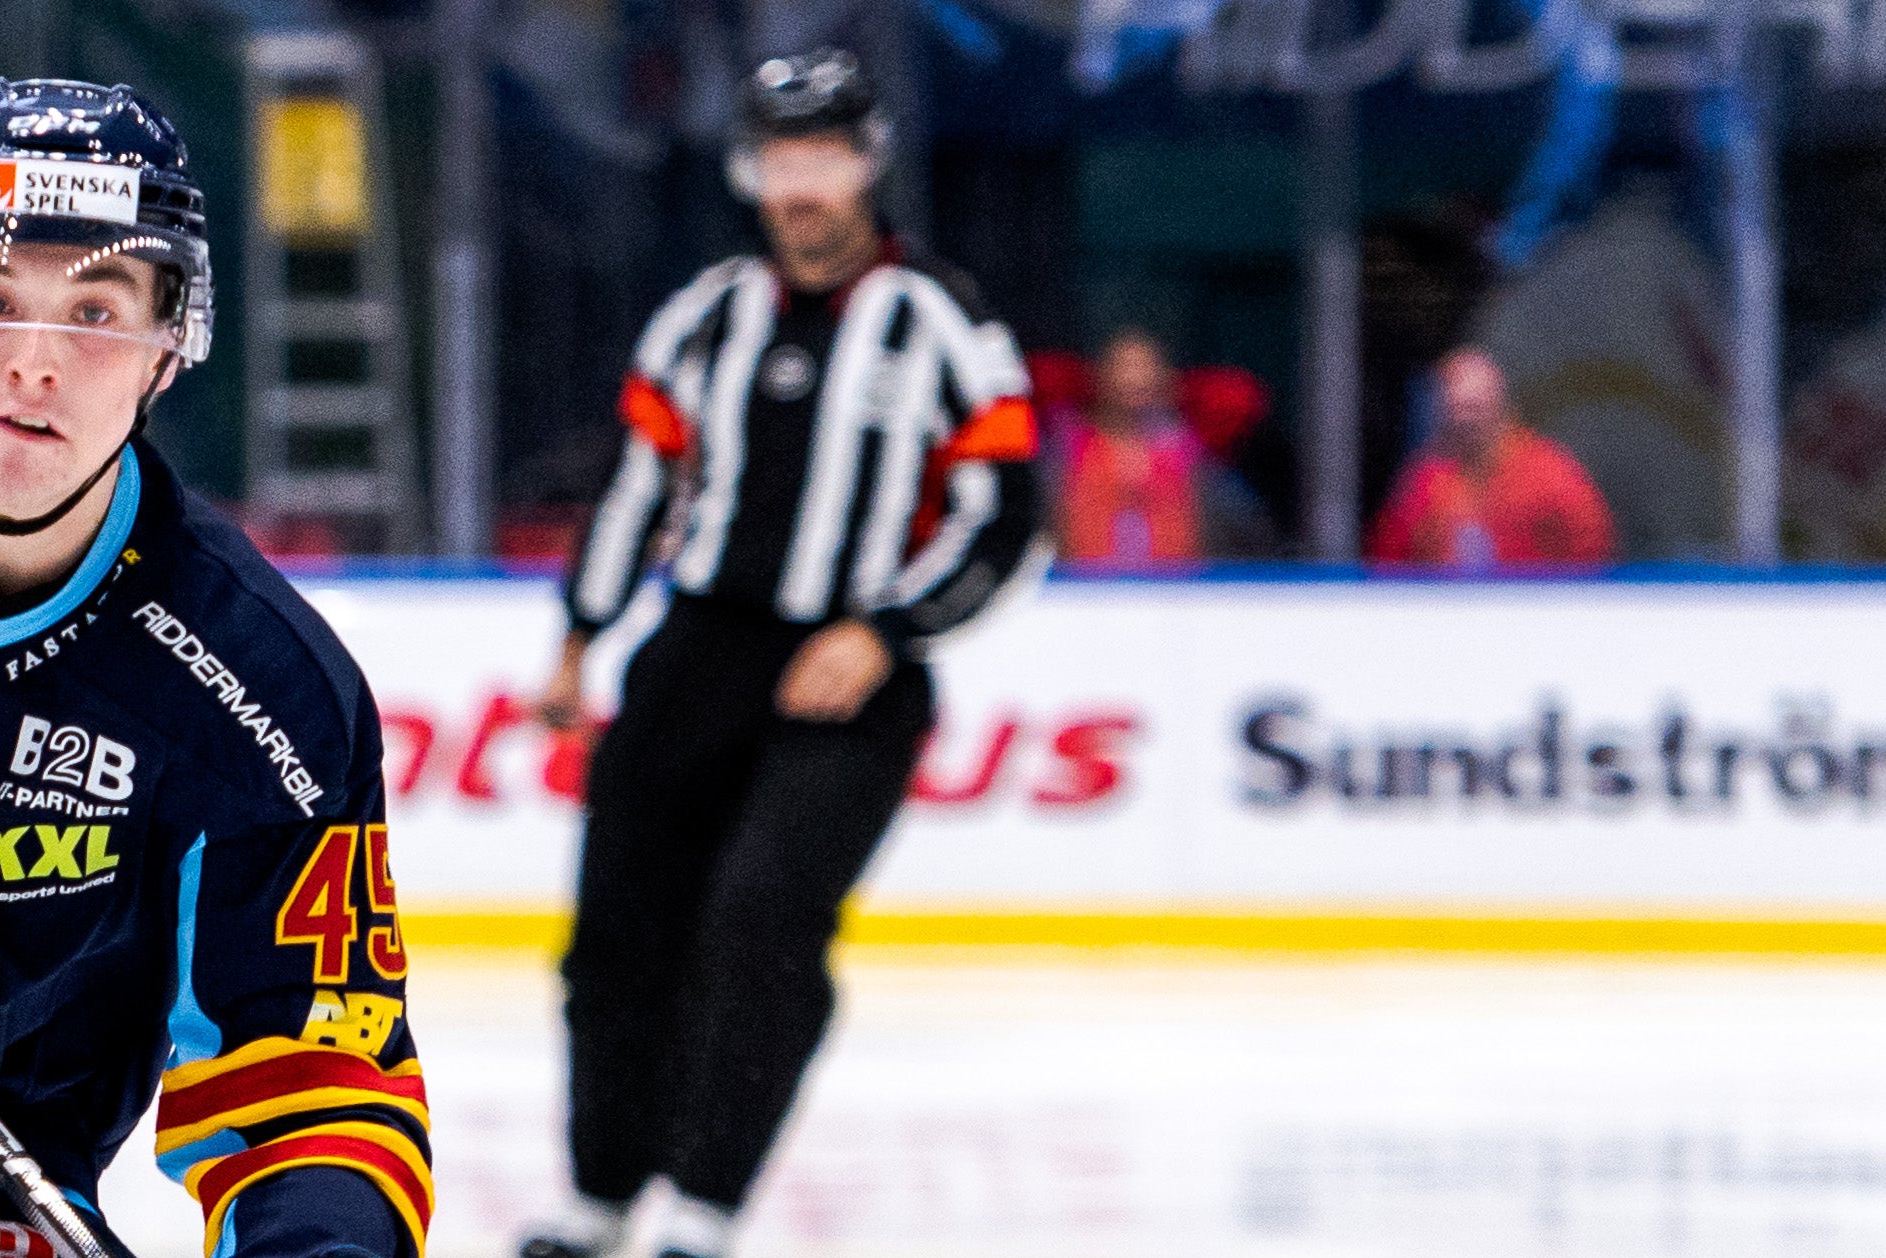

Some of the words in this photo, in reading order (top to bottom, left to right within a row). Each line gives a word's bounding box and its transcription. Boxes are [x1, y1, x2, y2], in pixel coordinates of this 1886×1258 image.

[24, 193, 80, 213] SPEL
[25, 171, 132, 199] SVENSKA
[5, 548, 142, 681] FASTAR
[9, 714, 137, 801] B2B
[132, 601, 301, 778] RIDDERMARK
[282, 766, 325, 818] BIL
[1232, 688, 1886, 810] Sundströ
[275, 823, 408, 985] 45
